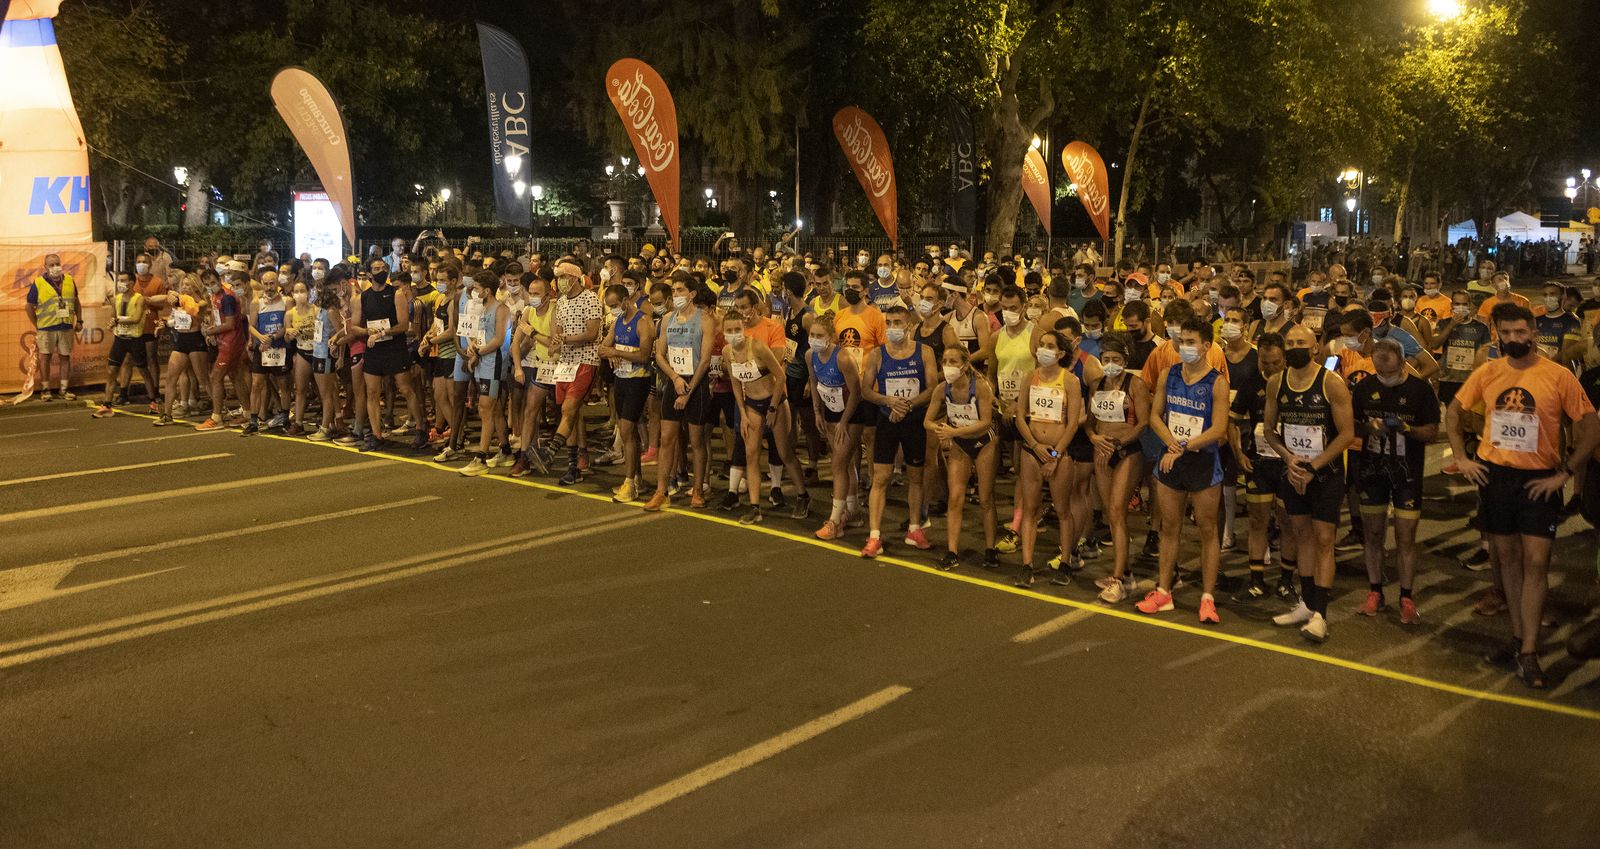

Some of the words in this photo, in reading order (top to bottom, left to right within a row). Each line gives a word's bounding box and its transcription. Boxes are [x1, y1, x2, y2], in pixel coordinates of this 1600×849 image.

[673, 356, 685, 365] 431
[1455, 355, 1466, 363] 27
[542, 368, 555, 376] 271
[738, 371, 754, 379] 442
[886, 369, 919, 377] TROTASIERRA
[1002, 380, 1016, 389] 135
[894, 389, 912, 398] 417
[1035, 397, 1054, 409] 492
[1096, 400, 1115, 411] 495
[1166, 394, 1206, 411] MARBELLA
[1173, 425, 1192, 437] 494
[1501, 424, 1527, 439] 280
[1292, 437, 1312, 449] 342
